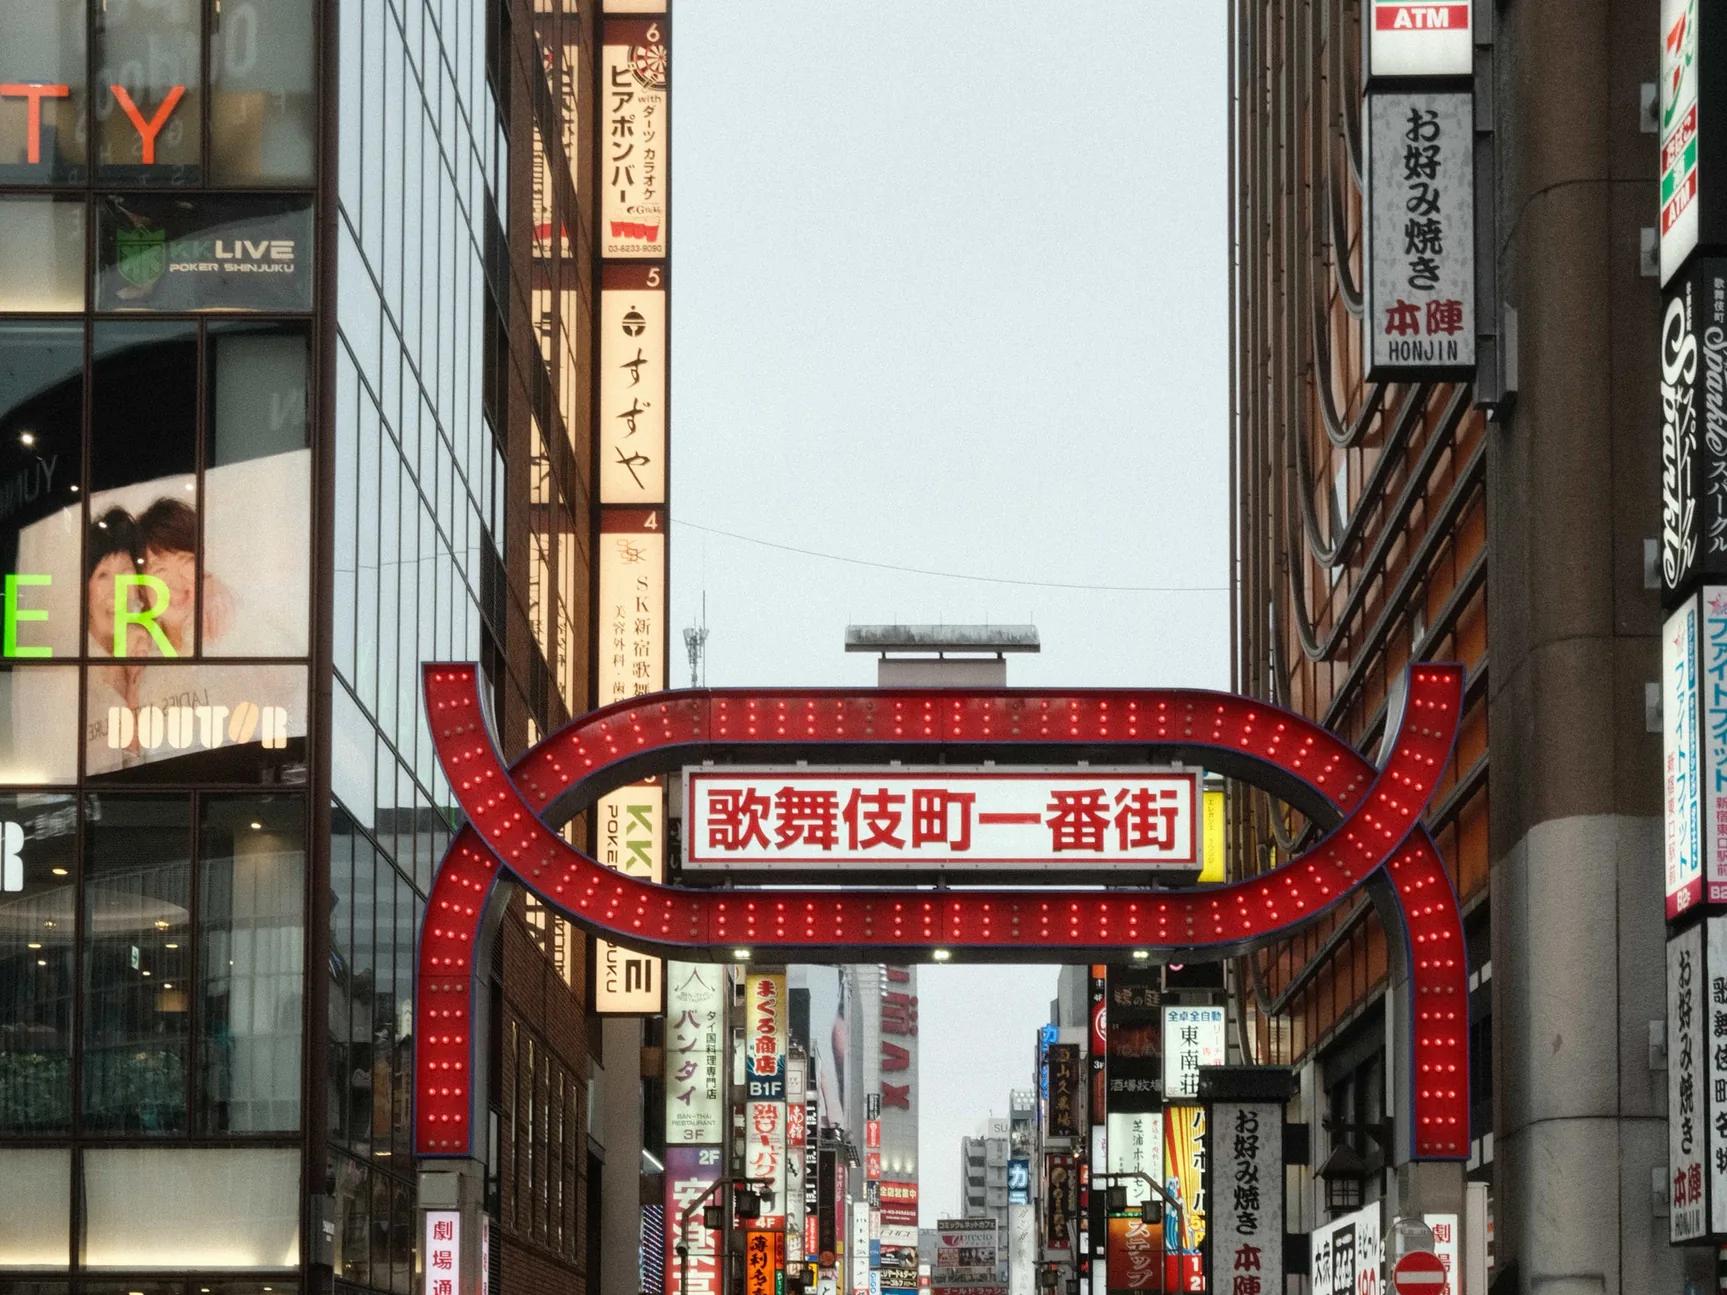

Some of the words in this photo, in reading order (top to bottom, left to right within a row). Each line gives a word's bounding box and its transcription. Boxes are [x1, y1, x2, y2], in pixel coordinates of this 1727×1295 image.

[646, 22, 661, 43] 6
[1393, 7, 1450, 29] ATM
[642, 104, 657, 143] ダーツ
[642, 147, 657, 201] カラオケ
[1403, 107, 1443, 292] お好み焼き
[1667, 177, 1691, 229] ATM
[169, 262, 219, 273] POKER
[223, 262, 295, 273] SHINJUKU
[646, 266, 661, 288] 5
[1384, 299, 1464, 337] 本陣
[1388, 339, 1458, 362] HONJIN
[613, 346, 652, 490] すずや
[643, 510, 658, 530] 4
[612, 604, 627, 702] 美容外科・歯
[107, 701, 288, 749] DOUTOR
[706, 785, 1179, 852] 歌舞伎町一番街
[754, 978, 777, 1075] まぐろ商店
[1167, 1010, 1222, 1022] 全卓全自動
[673, 1008, 701, 1107] バンタイ
[706, 1010, 717, 1100] タイ国料理専門店
[1180, 1024, 1199, 1096] 東南荘
[1678, 949, 1695, 1157] お好み焼き
[749, 1081, 782, 1096] B1F
[671, 1119, 716, 1127] RESTAURANT
[683, 1129, 705, 1141] 3F
[698, 1149, 721, 1166] 2F
[1233, 1109, 1260, 1236] お好み焼き
[1673, 1162, 1703, 1207] 本陣
[755, 1216, 776, 1229] 4F
[1124, 1220, 1153, 1289] ステップ
